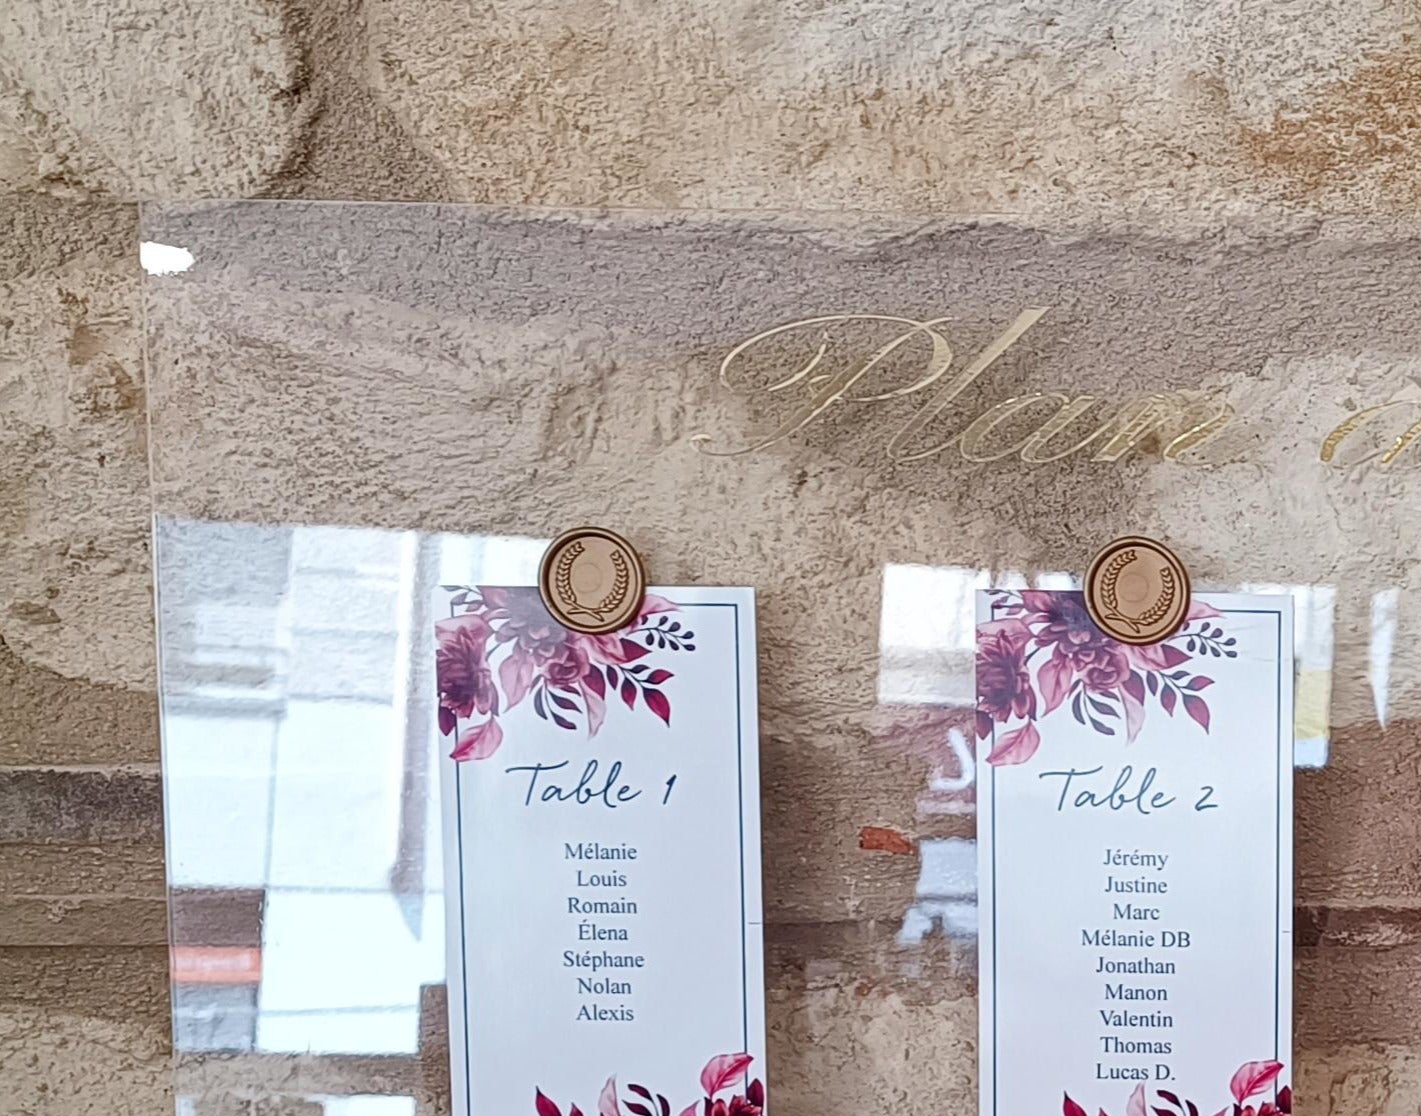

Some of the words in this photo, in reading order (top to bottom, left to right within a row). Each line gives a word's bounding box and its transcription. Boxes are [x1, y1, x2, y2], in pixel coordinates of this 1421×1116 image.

[690, 306, 1238, 463] Plan
[505, 759, 642, 808] Table
[663, 774, 677, 805] 1
[1039, 765, 1176, 815] Table
[1195, 786, 1218, 811] 2
[565, 843, 637, 860] Mélanie
[1103, 849, 1168, 871] Jérémy
[578, 870, 627, 886] Louis
[1105, 876, 1167, 893] Justine
[568, 897, 637, 914] Romain
[1114, 904, 1160, 920] Marc
[579, 919, 628, 940] Élena
[1082, 929, 1155, 947] Mélanie
[1161, 931, 1190, 948] DB
[564, 951, 645, 972] Stéphane
[1096, 957, 1175, 974] Jonathan
[577, 978, 631, 994] Nolan
[1105, 984, 1168, 1000] Manon
[576, 1004, 634, 1021] Alexis
[1100, 1010, 1173, 1027] Valentin
[1100, 1036, 1172, 1054] Thomas
[1096, 1063, 1149, 1080] Lucas
[1155, 1064, 1175, 1080] D.
